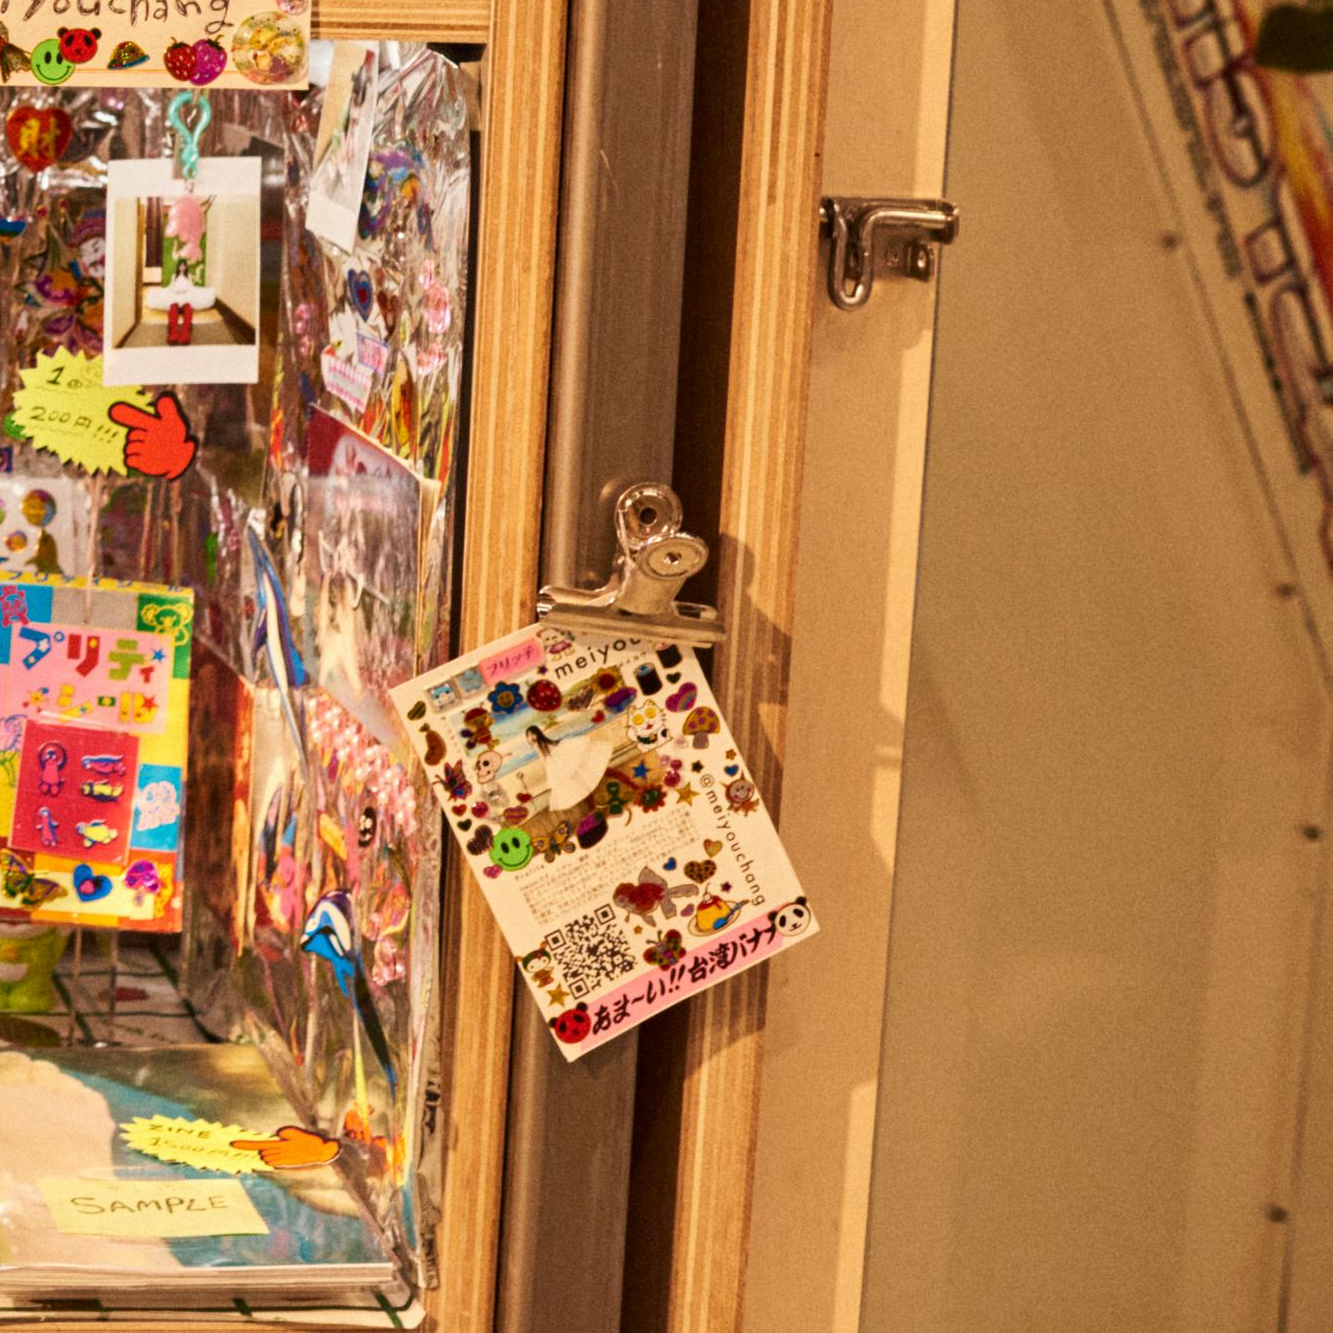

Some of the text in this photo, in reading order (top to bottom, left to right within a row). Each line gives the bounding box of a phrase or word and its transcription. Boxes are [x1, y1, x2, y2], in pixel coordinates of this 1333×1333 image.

[19, 626, 156, 684] プリティ
[700, 774, 766, 906] @meiyouchang
[70, 1195, 229, 1215] SAMPLE
